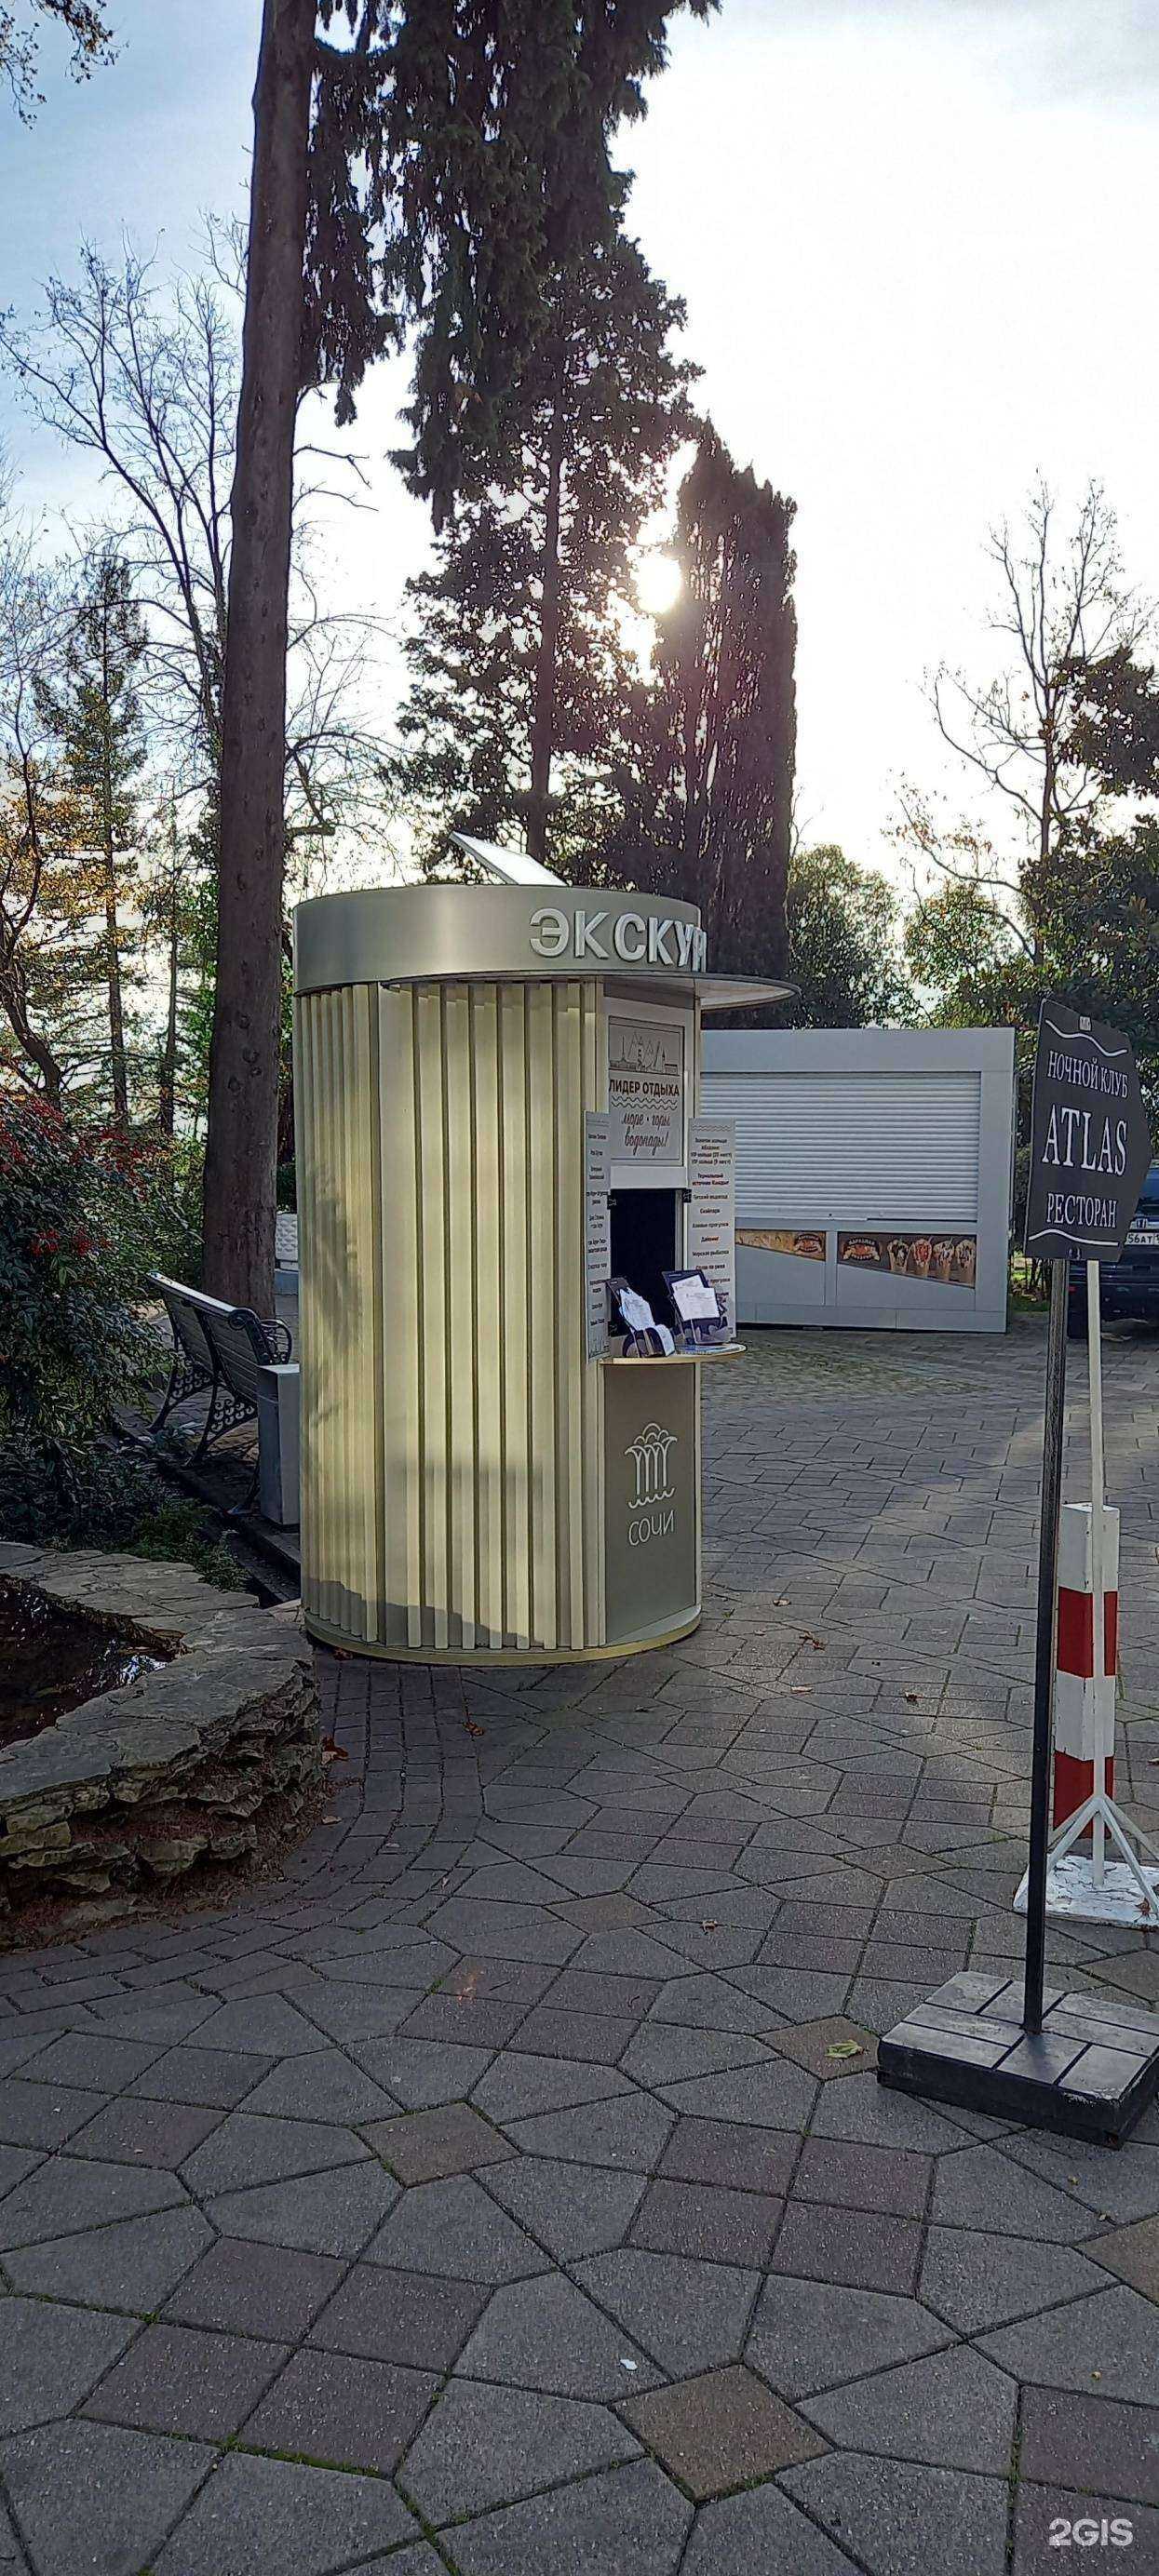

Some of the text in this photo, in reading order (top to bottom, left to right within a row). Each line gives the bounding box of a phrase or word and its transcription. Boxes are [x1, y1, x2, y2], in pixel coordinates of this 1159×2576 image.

[609, 1080, 680, 1098] ЛИДЕР ОТДЫХА
[1047, 1050, 1128, 1099] НОЧНОЙ КЛУБ
[622, 1113, 644, 1129] море
[1042, 1104, 1127, 1176] ATLAS
[1046, 1193, 1117, 1228] РЕСТОРАН
[628, 1509, 675, 1547] СОЧИ
